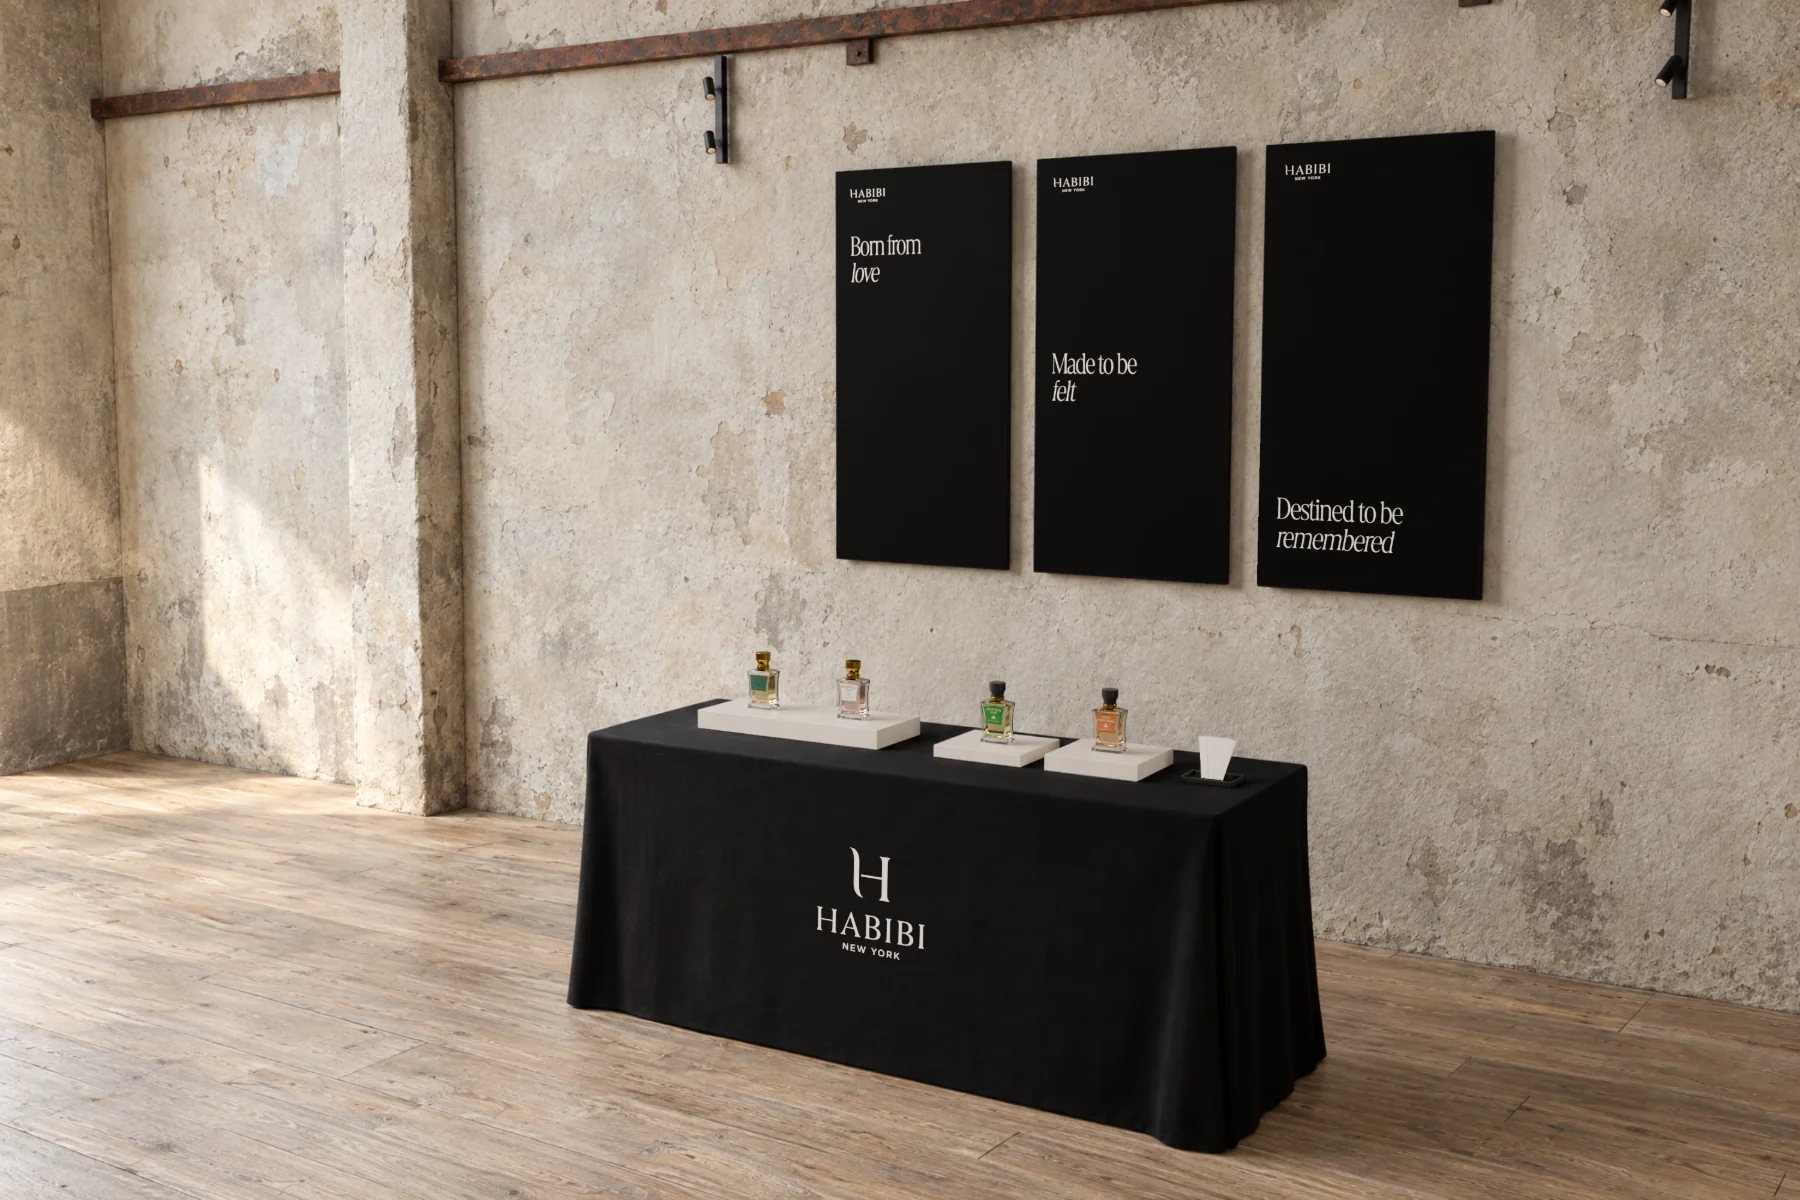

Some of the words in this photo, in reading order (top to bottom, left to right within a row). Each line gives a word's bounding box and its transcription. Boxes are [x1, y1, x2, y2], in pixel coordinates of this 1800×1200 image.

[1285, 163, 1331, 176] HABIBI
[849, 187, 886, 199] HABIBI
[1053, 176, 1094, 188] HABIBI
[850, 235, 885, 257] Born
[887, 233, 922, 256] from
[850, 262, 881, 284] love
[1051, 352, 1096, 375] Made
[1097, 354, 1115, 375] to
[1116, 352, 1138, 375] be
[1051, 379, 1078, 403] felt
[1276, 496, 1355, 523] Destined
[1357, 502, 1377, 524] to
[1379, 500, 1404, 525] be
[1275, 528, 1396, 554] remembered
[849, 846, 891, 903] H
[816, 905, 926, 950] HABIBI
[841, 942, 867, 955] NEW
[870, 947, 901, 961] YORK
